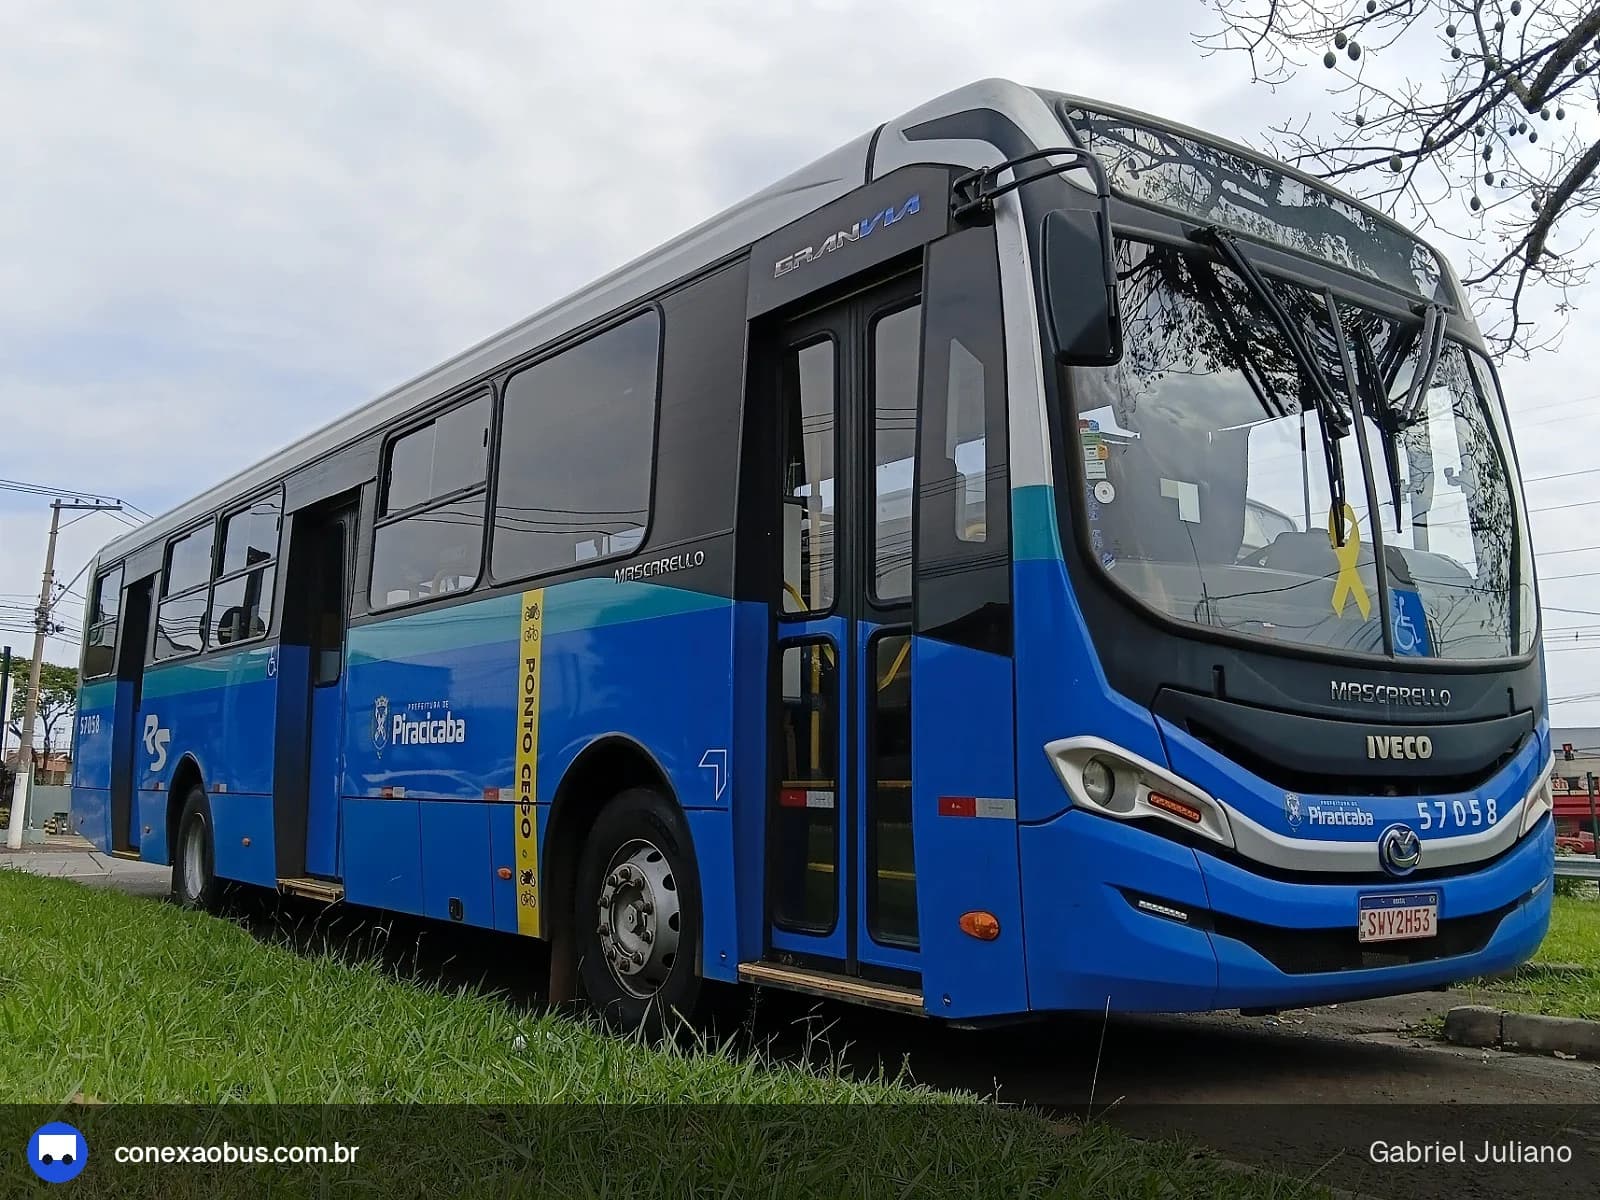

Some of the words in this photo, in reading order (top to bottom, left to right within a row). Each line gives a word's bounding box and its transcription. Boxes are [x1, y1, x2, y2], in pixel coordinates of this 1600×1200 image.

[614, 550, 705, 584] MASCARELLO
[523, 658, 536, 753] PONTO
[1331, 680, 1451, 707] MASCARELLO
[80, 714, 100, 735] 57058
[392, 711, 465, 745] Piracicaba
[1366, 735, 1433, 760] IVECO
[521, 763, 531, 838] CEGO
[1417, 798, 1497, 829] 57058
[1308, 806, 1374, 826] Piracicaba
[1368, 908, 1430, 936] SWY2H53
